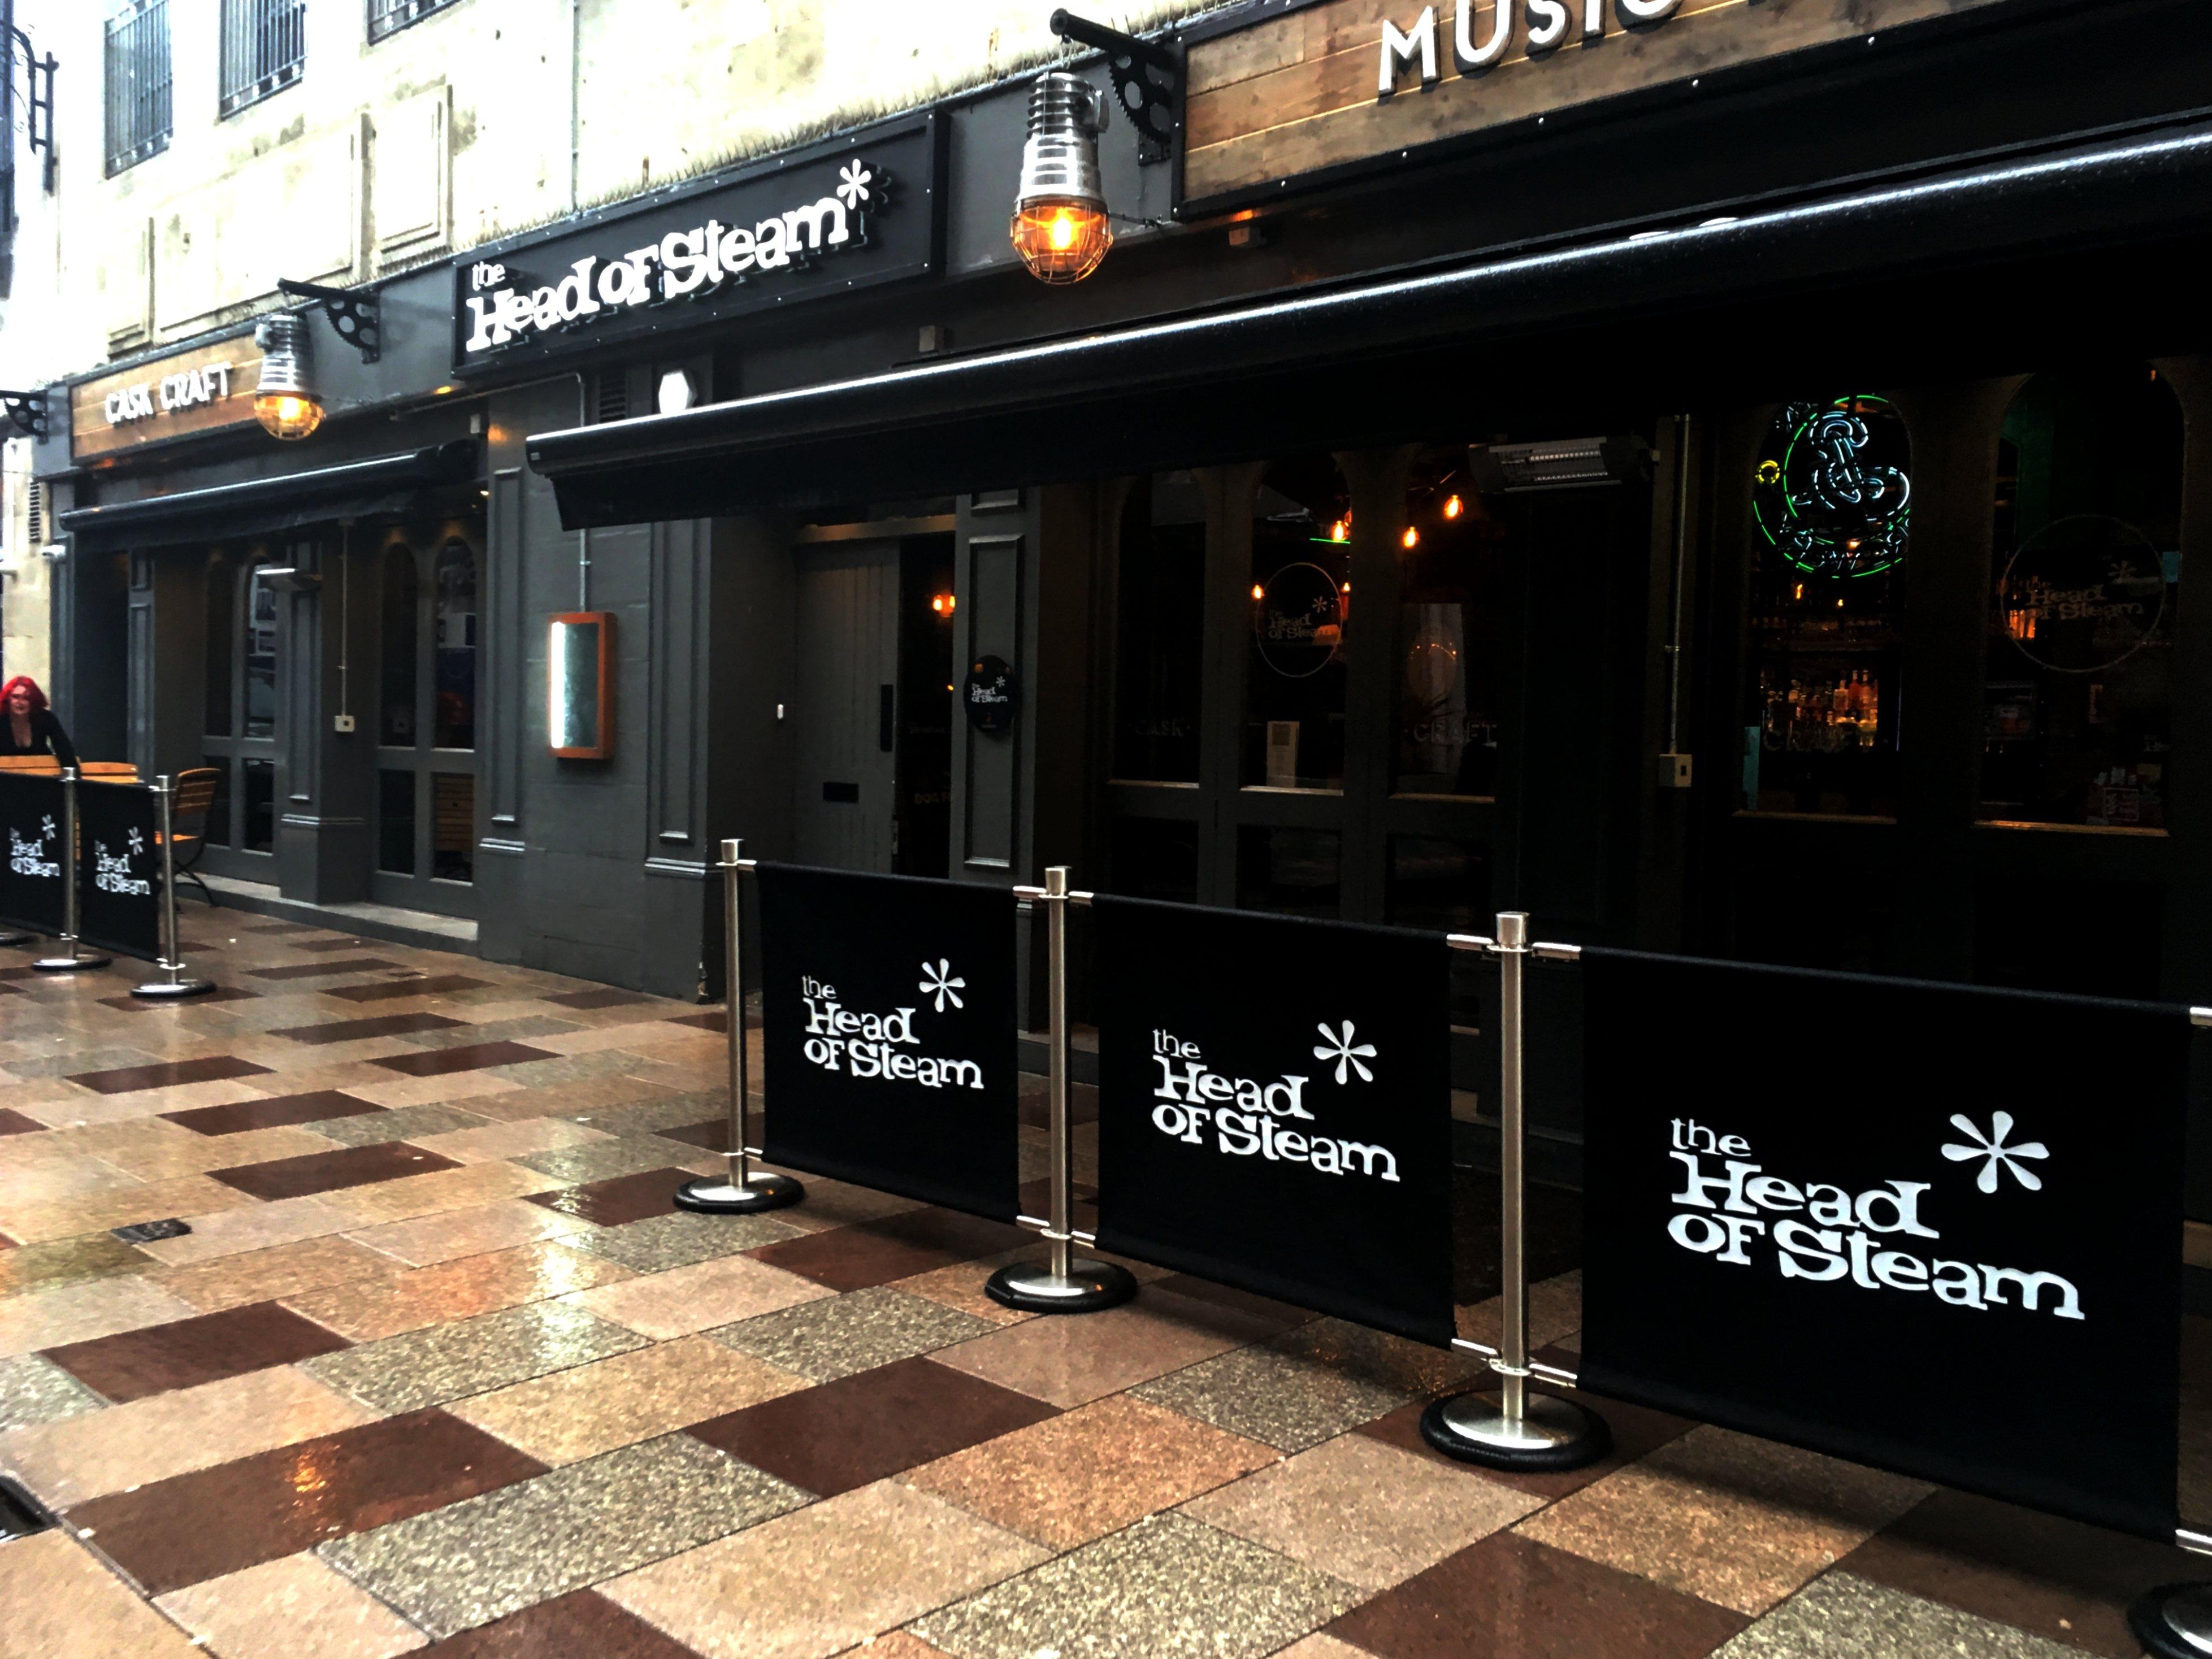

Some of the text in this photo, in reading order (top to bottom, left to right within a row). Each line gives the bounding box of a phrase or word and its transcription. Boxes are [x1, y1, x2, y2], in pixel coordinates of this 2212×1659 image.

[466, 256, 600, 351] Head
[660, 198, 848, 298] Steam
[472, 262, 505, 290] the
[105, 360, 232, 424] CASK CRAFT
[10, 838, 44, 857] Head
[23, 857, 60, 877] Steam
[94, 852, 132, 873] Head
[110, 872, 151, 896] Steam
[803, 976, 837, 999] the
[803, 997, 920, 1044] Head
[848, 1039, 984, 1089] Steam
[1153, 1029, 1201, 1058] the
[1153, 1055, 1315, 1120] Head
[1216, 1108, 1400, 1182] Steam
[1671, 1118, 1751, 1156] the
[1669, 1151, 1939, 1239] Head
[1773, 1219, 2085, 1319] Steam
